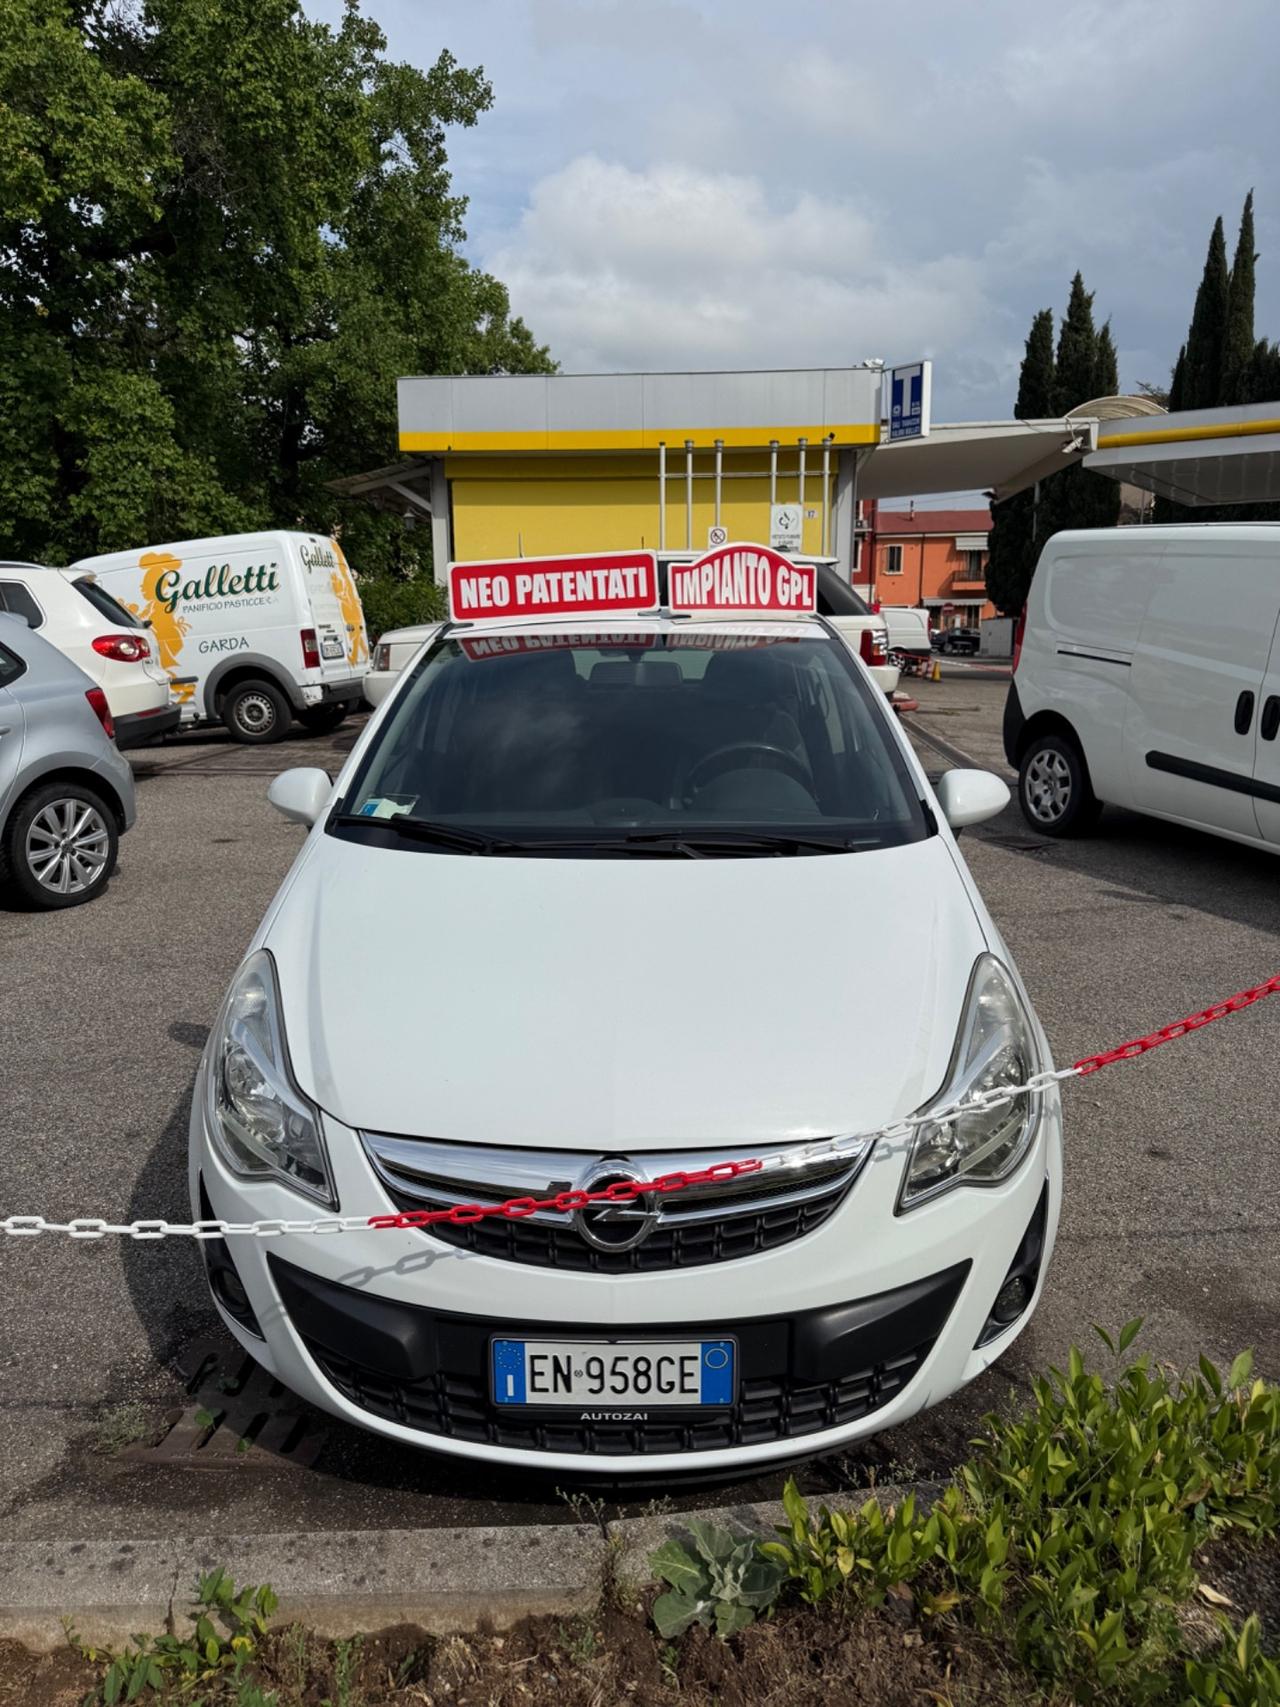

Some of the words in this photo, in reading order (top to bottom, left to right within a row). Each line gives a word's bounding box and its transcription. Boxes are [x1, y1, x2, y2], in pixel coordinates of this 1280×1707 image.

[300, 545, 334, 573] Gallett
[155, 563, 280, 614] Galletti
[459, 576, 510, 609] NEO
[515, 566, 648, 605] PATENTATI
[675, 551, 771, 606] IMPIANTO
[776, 565, 812, 606] GPL
[182, 602, 223, 613] PANIFICIO
[198, 636, 250, 654] GARDA
[529, 1354, 573, 1394] EN
[585, 1355, 700, 1395] 958GE
[580, 1412, 649, 1421] AUTOZAI
